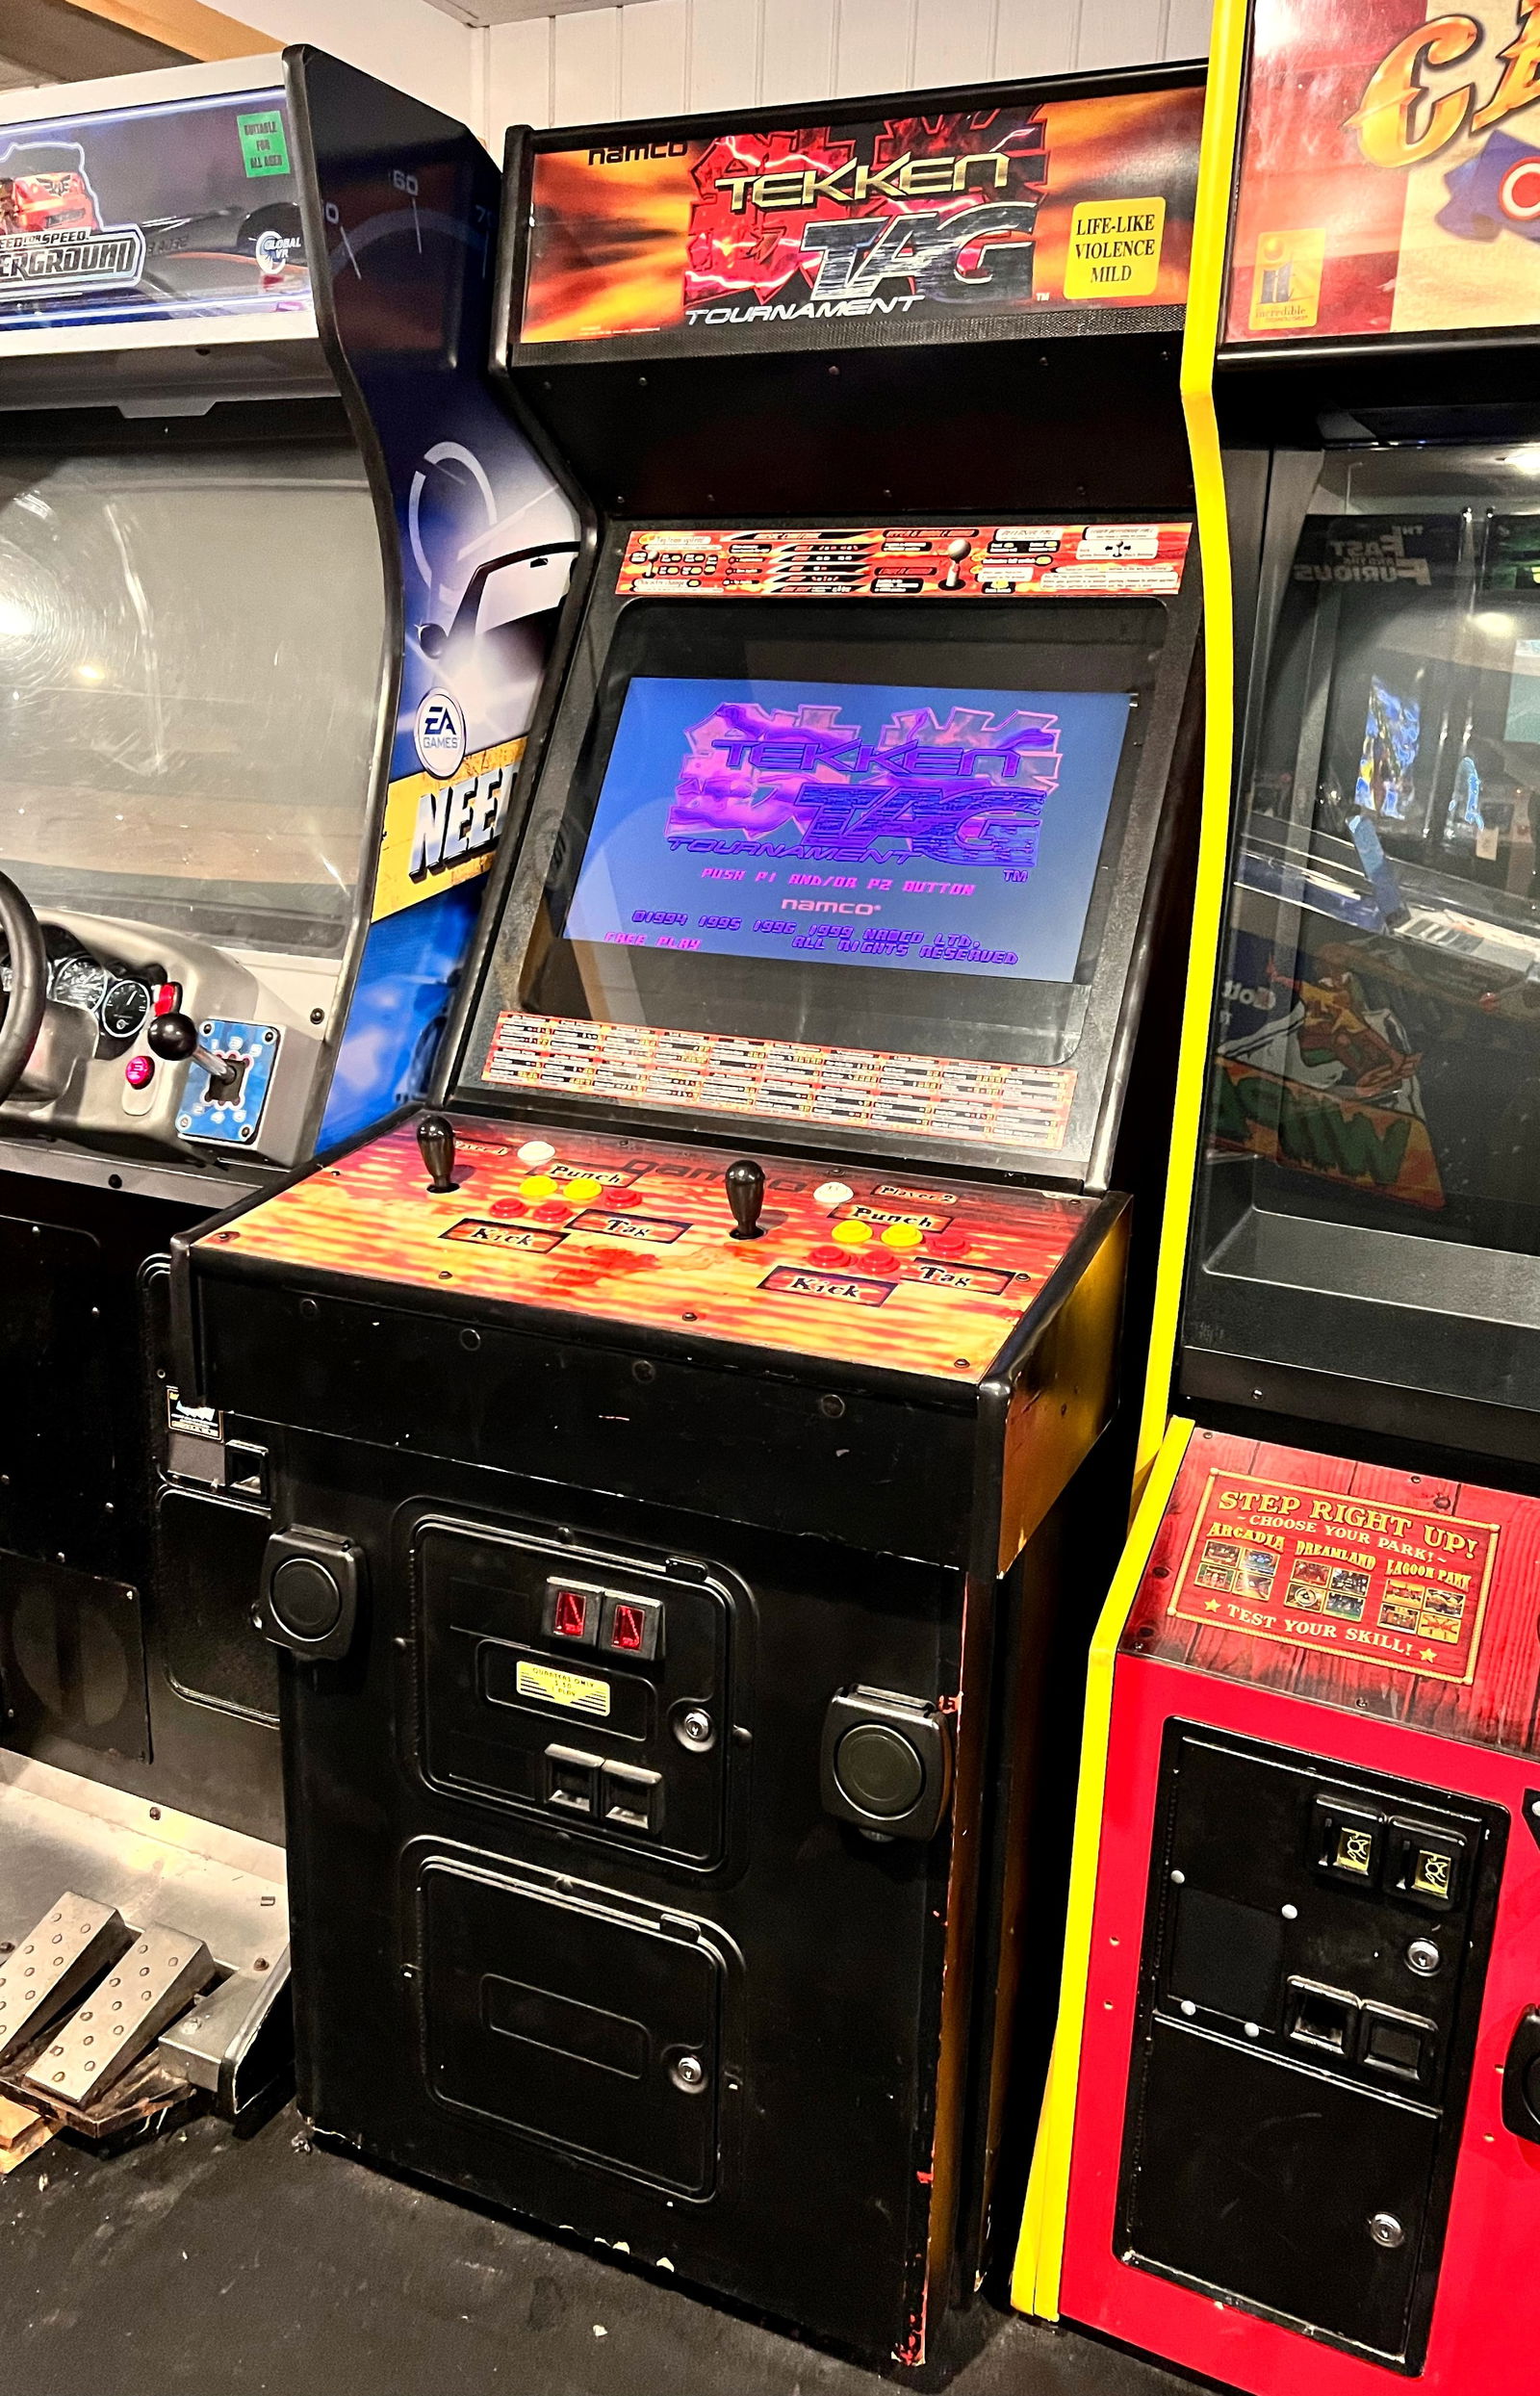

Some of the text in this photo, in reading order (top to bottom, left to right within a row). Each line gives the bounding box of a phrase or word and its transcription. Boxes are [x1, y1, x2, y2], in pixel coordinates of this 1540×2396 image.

[250, 156, 263, 168] ALL
[715, 152, 1011, 212] TEKKEN
[1076, 214, 1155, 236] LIFE-LIKE
[264, 237, 301, 248] GLOBAL
[276, 248, 289, 258] VR
[800, 201, 1038, 301] TAG
[1075, 239, 1155, 259] VIOLENCE
[1091, 265, 1132, 283] MILD
[684, 295, 925, 326] TOURNAMENT
[424, 707, 456, 734] EA
[424, 736, 458, 749] GAMES
[711, 738, 1021, 778] TEKKEN
[794, 783, 1047, 866] TAG
[666, 835, 926, 865] TOURNAMENT
[701, 867, 976, 896] PUSH P1 AND/OR P2 BUTTON
[1003, 869, 1028, 883] TM
[603, 931, 703, 950] FREE PLAY
[698, 915, 742, 931] 1995
[753, 919, 797, 934] 1996
[808, 923, 855, 940] 1999
[862, 927, 925, 944] NAMCO
[934, 933, 981, 948] LTD.
[792, 935, 1019, 966] ALL RIGHTS RESERVED
[549, 1164, 622, 1184] Punch
[622, 1159, 808, 1193] namo
[881, 1185, 954, 1203] Player 2
[605, 1219, 651, 1238] Tag
[852, 1205, 933, 1229] Punch
[471, 1226, 534, 1247] Kick
[790, 1276, 860, 1299] Kick
[920, 1265, 972, 1288] Tag
[1206, 1522, 1286, 1554] ARCADIA
[1218, 1491, 1478, 1559] STEP RIGHT UP!
[1248, 1514, 1434, 1563] CHOOSE YOUR PARK!
[1295, 1540, 1376, 1571] DREAMLAND
[1386, 1559, 1473, 1592] LAGOON PARK
[1227, 1604, 1413, 1656] TEST YOUR SKILL!
